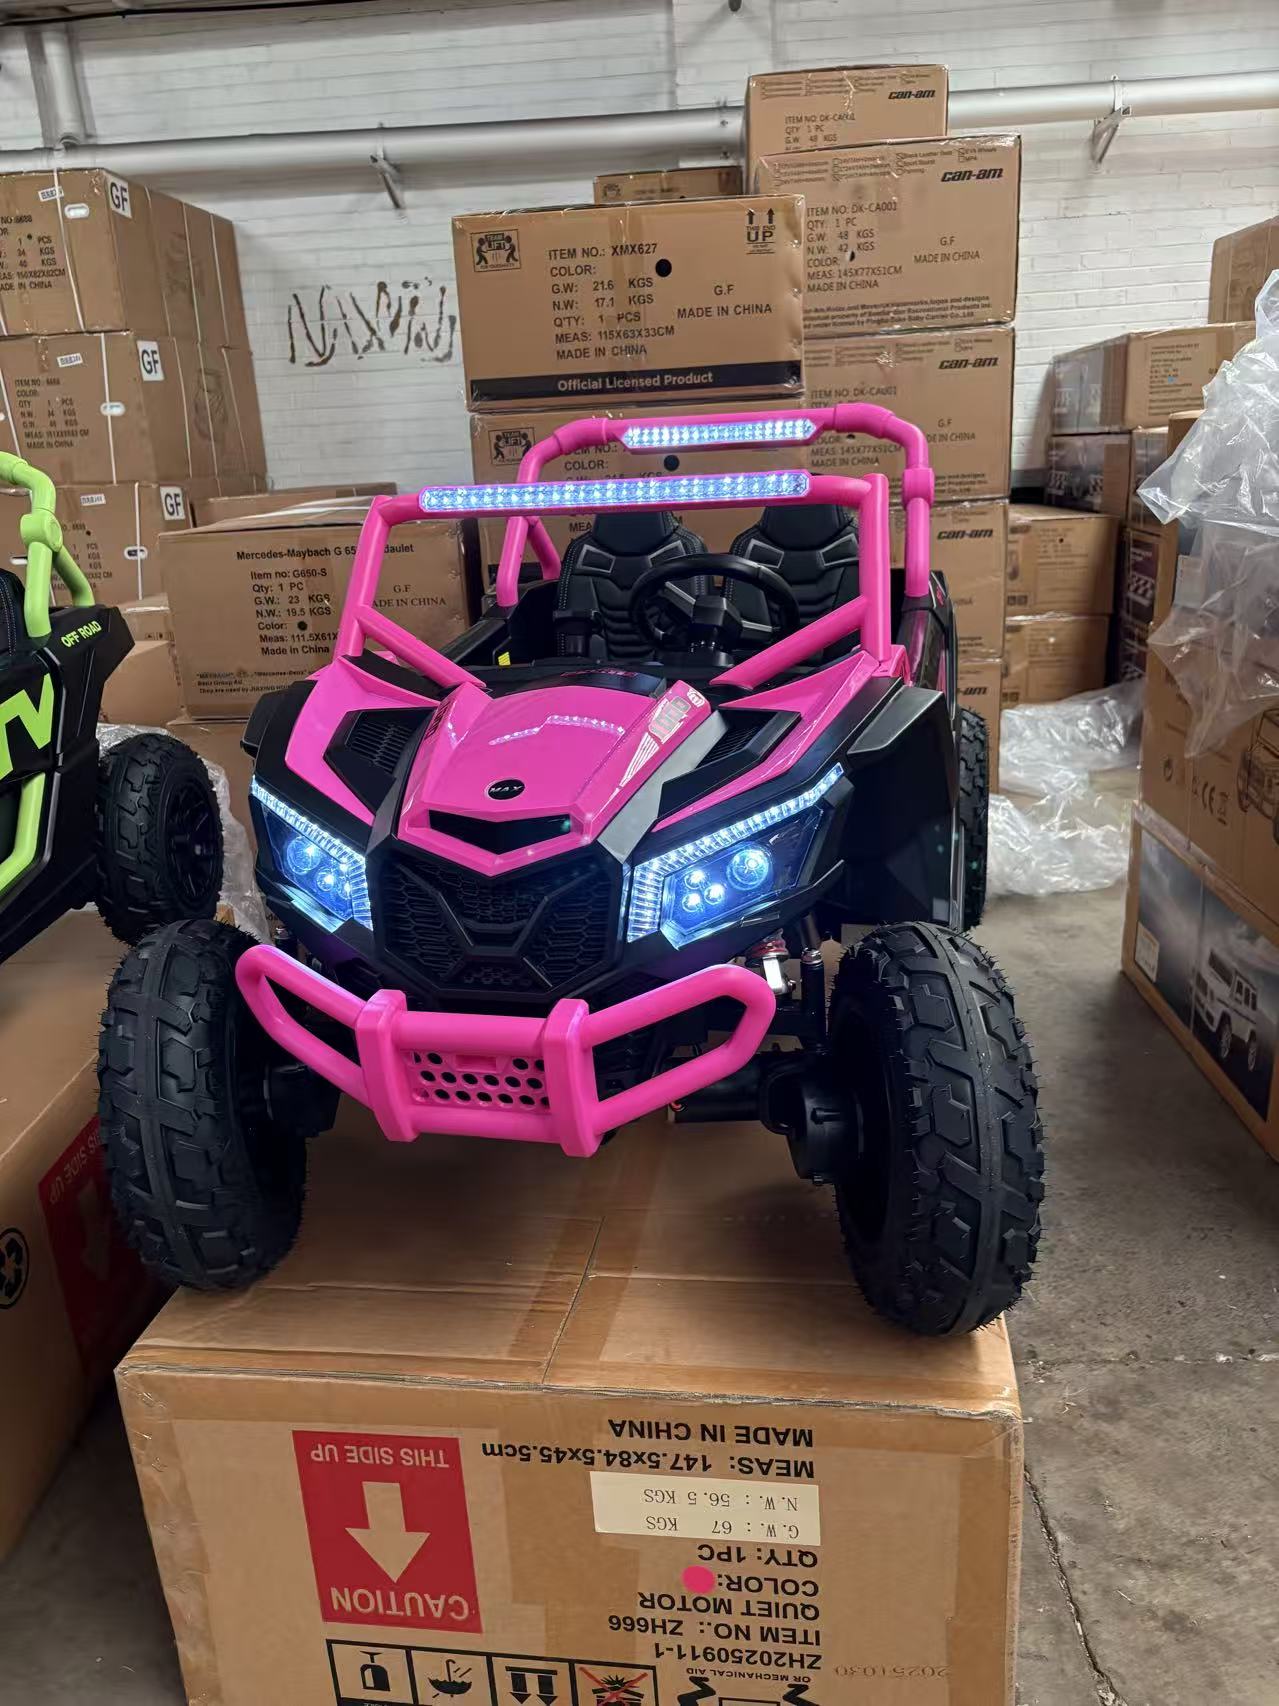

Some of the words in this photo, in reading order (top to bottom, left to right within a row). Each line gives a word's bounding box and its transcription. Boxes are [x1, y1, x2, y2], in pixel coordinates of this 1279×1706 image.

[888, 89, 936, 100] can-am
[785, 114, 802, 123] ITEM
[941, 168, 1003, 182] can-am
[110, 182, 129, 212] GF
[807, 207, 829, 217] ITEM
[832, 206, 849, 216] NO:
[846, 218, 857, 226] PC
[747, 230, 773, 242] UP
[838, 231, 848, 240] 48
[856, 229, 874, 239] KGS
[40, 247, 55, 256] KGS
[549, 249, 577, 260] ITEM
[582, 247, 605, 258] NO.:
[611, 243, 657, 256] XMX627
[838, 244, 848, 252] 42
[857, 242, 875, 251] KGS
[41, 258, 56, 266] KGS
[914, 253, 939, 264] MADE
[941, 252, 951, 262] IN
[952, 250, 980, 261] CHINA
[550, 265, 596, 277] COLOR:
[29, 281, 52, 289] CHINA
[551, 283, 578, 294] G.W:
[593, 280, 614, 291] 21.6
[628, 278, 653, 288] KGS
[713, 284, 734, 296] G.F
[807, 282, 834, 293] MADE
[836, 281, 847, 291] IN
[849, 279, 879, 290] CHINA
[552, 300, 578, 311] N.W:
[595, 297, 614, 307] 17.1
[628, 294, 654, 305] KGS
[599, 315, 604, 323] 1
[617, 312, 641, 323] PCS
[677, 307, 712, 319] MADE
[717, 305, 729, 316] IN
[734, 303, 772, 315] CHINA
[555, 332, 592, 344] MEAS:
[598, 325, 675, 340] 115X63X33CM
[556, 347, 590, 360] MADE
[595, 347, 606, 357] IN
[611, 345, 647, 356] CHINA
[141, 348, 160, 375] GF
[938, 357, 998, 370] can-am
[558, 378, 602, 391] Official
[606, 375, 660, 389] Licensed
[664, 371, 713, 386] Product
[811, 390, 832, 399] ITEM
[939, 433, 949, 441] IN
[950, 431, 976, 442] CHINA
[26, 441, 45, 449] MADE
[54, 440, 74, 448] CHINA
[564, 460, 608, 471] COLOR:
[811, 458, 837, 467] MADE
[839, 458, 849, 466] IN
[851, 456, 880, 465] CHINA
[164, 493, 182, 517] GF
[937, 529, 993, 541] can-am
[236, 547, 331, 560] Mercedes-Maybach
[334, 546, 342, 556] G
[251, 571, 272, 580] Item
[275, 569, 290, 578] no:
[293, 568, 327, 577] G650-S
[252, 584, 273, 594] Qty:
[278, 583, 284, 592] 1
[290, 582, 304, 591] PC
[393, 584, 411, 593] G.F
[254, 596, 280, 606] G.W.:
[288, 595, 300, 604] 23
[308, 594, 331, 603] KGS
[373, 599, 394, 607] ADE
[411, 597, 446, 606] CHINA
[256, 609, 281, 618] N.W.:
[286, 608, 305, 617] 19.5
[310, 607, 331, 616] KGS
[258, 621, 287, 630] Color:
[61, 631, 79, 648] OFF
[77, 620, 102, 641] ROAD
[259, 634, 288, 643] Meas:
[261, 647, 287, 656] Made
[302, 644, 329, 653] China
[608, 1419, 692, 1441] CHINA
[700, 1423, 725, 1443] IN
[735, 1425, 813, 1448] MADE
[310, 1443, 339, 1462] UP
[344, 1445, 394, 1465] SIDE
[400, 1448, 450, 1468] THIS
[481, 1442, 712, 1472] 147.5x84.5x45.5cm
[730, 1455, 814, 1479] MEAS:
[643, 1488, 677, 1504] KGS
[645, 1516, 678, 1531] KGS
[711, 1519, 733, 1535] 67
[697, 1543, 747, 1563] 1PC
[756, 1548, 819, 1568] QTY:
[717, 1574, 820, 1597] COLOR:
[330, 1586, 470, 1621] CAUTION
[637, 1592, 733, 1615] MOTOR
[740, 1599, 821, 1622] QUIET
[608, 1615, 684, 1637] ZH666
[699, 1620, 751, 1641] NO.:
[760, 1626, 821, 1646] ITEM
[654, 1642, 823, 1670] ZH20250911-1
[686, 1667, 708, 1675] AID
[709, 1669, 789, 1681] MECHANICAL
[792, 1675, 812, 1683] OR
